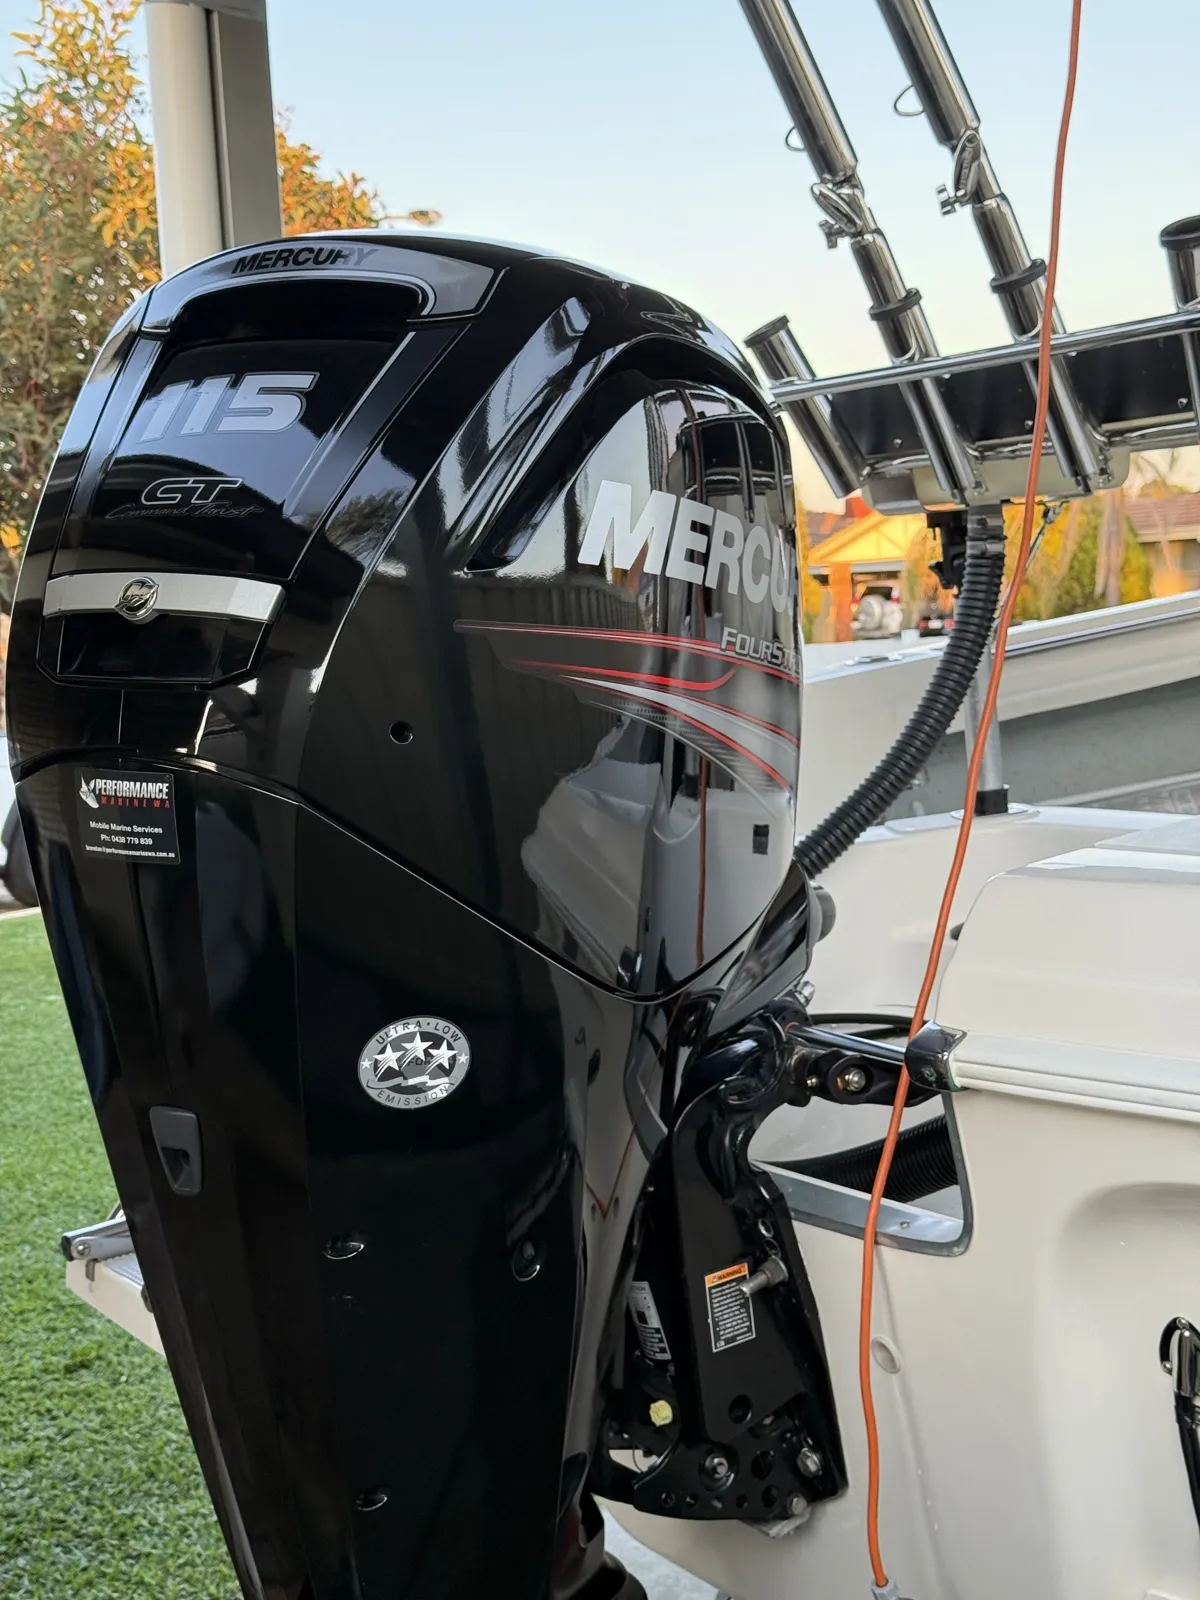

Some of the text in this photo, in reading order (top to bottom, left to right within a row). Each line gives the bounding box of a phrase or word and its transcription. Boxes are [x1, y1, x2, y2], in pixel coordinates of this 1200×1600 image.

[231, 247, 379, 274] MERCURY
[136, 372, 320, 444] 115
[105, 501, 265, 519] Command Thrust
[577, 479, 796, 616] MERCU
[95, 778, 169, 799] PERFORMANCE
[101, 795, 147, 808] MARINE
[89, 820, 163, 834] Mobile Marine Services
[375, 1020, 461, 1045] ULTRA LOW
